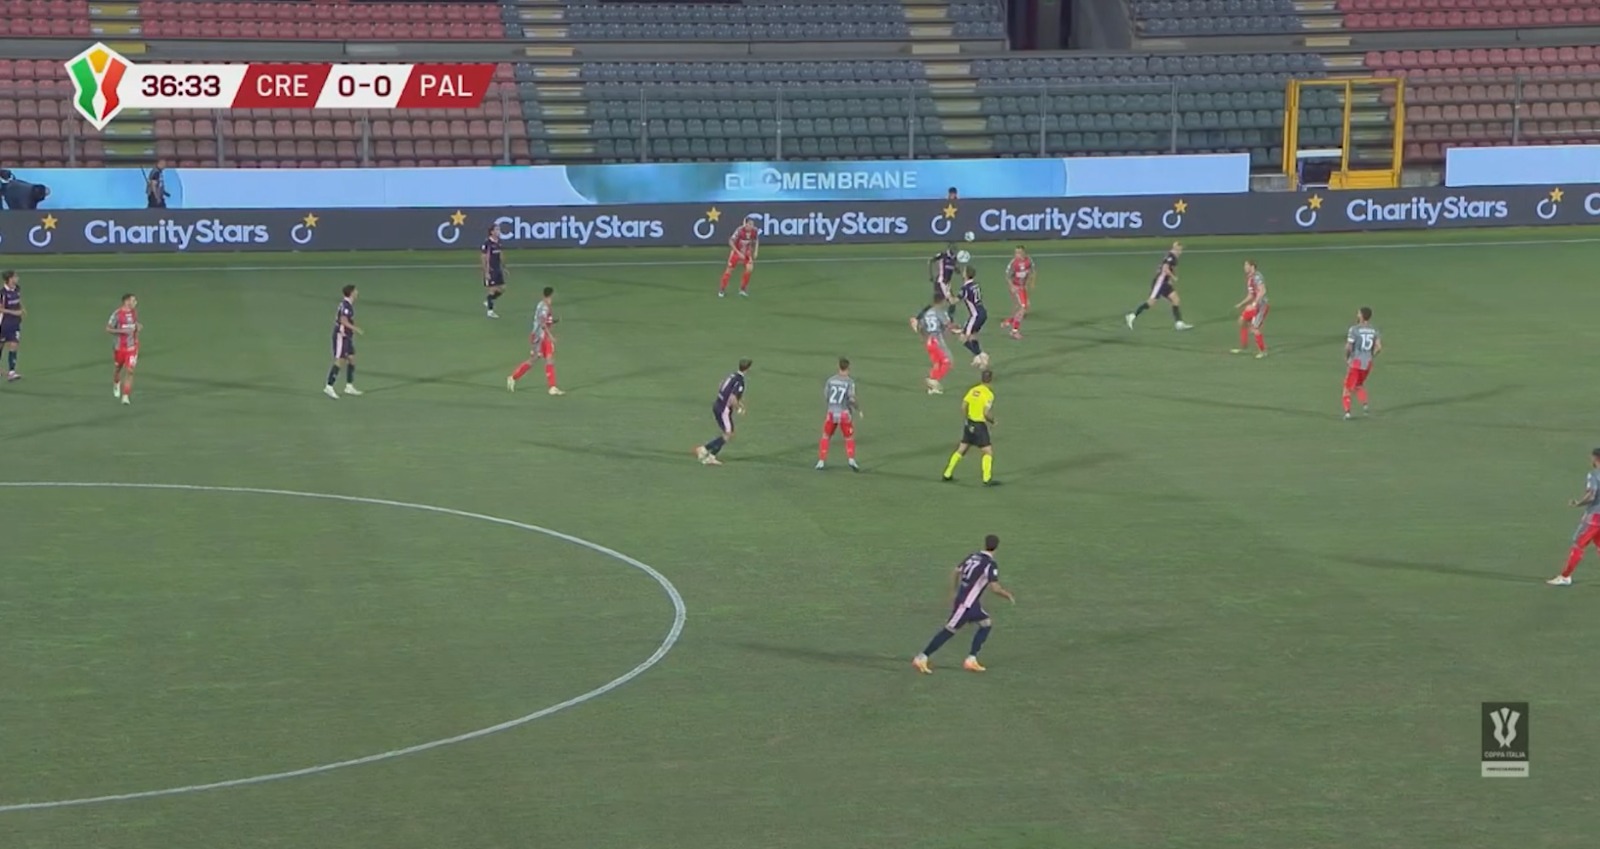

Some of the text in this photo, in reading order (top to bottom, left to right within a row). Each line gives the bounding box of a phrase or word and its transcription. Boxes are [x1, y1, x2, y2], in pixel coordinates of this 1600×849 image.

[979, 206, 1143, 236] CharityStars
[1346, 196, 1508, 225] CharityStars
[84, 218, 269, 249] CharityStars
[494, 214, 664, 244] CharityStars
[1361, 334, 1374, 350] 15
[829, 385, 847, 404] 27
